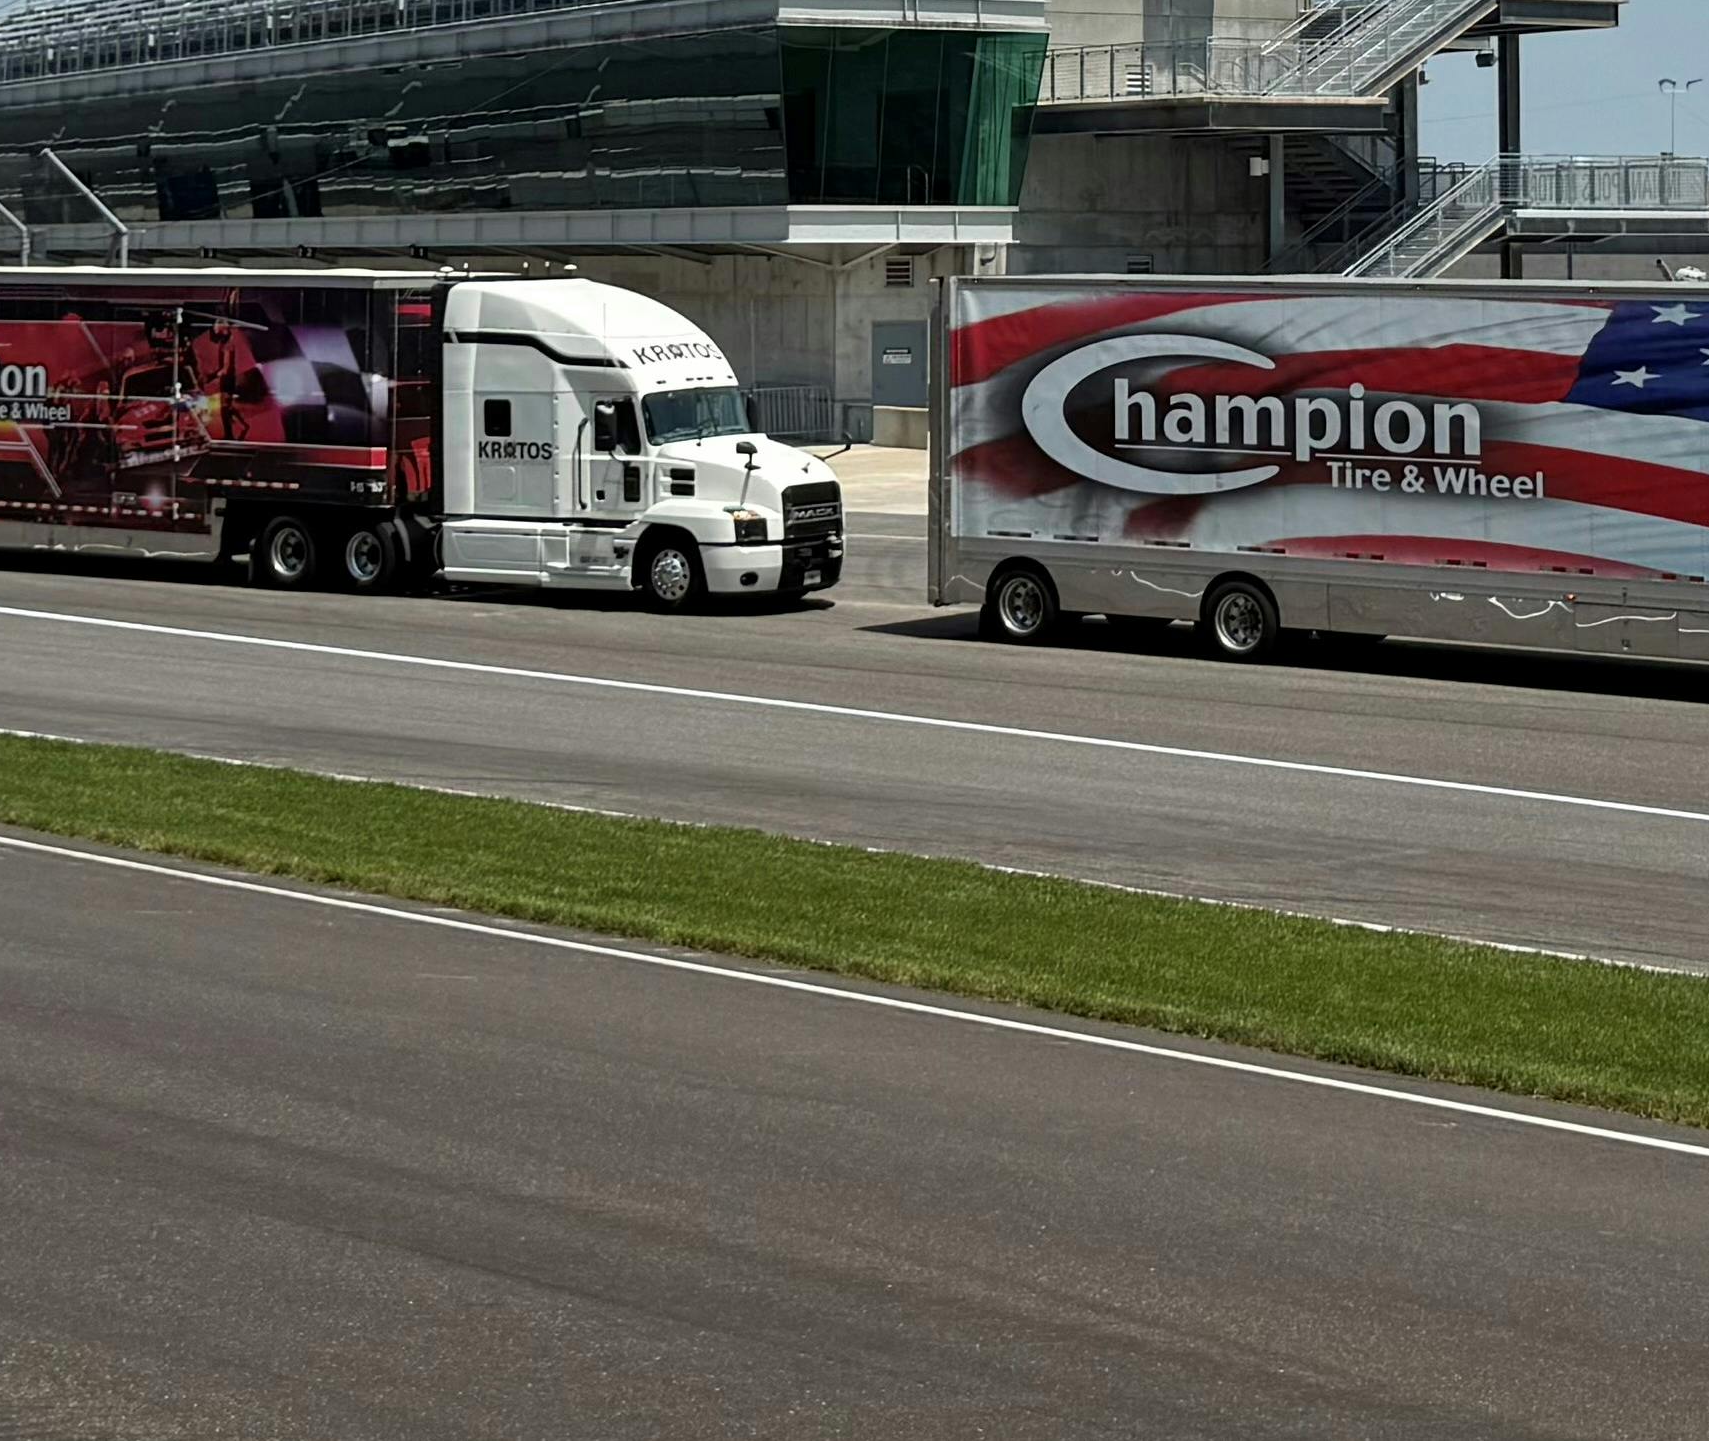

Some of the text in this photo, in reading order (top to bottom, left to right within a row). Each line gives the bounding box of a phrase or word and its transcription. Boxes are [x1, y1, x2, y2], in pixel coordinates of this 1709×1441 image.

[632, 342, 723, 366] KRATOS
[10, 403, 22, 419] &
[24, 402, 71, 421] Wheel
[1021, 332, 1483, 495] Champion
[478, 440, 553, 460] KRATOS
[1326, 461, 1547, 499] Tire & Wheel
[793, 507, 835, 519] MACK
